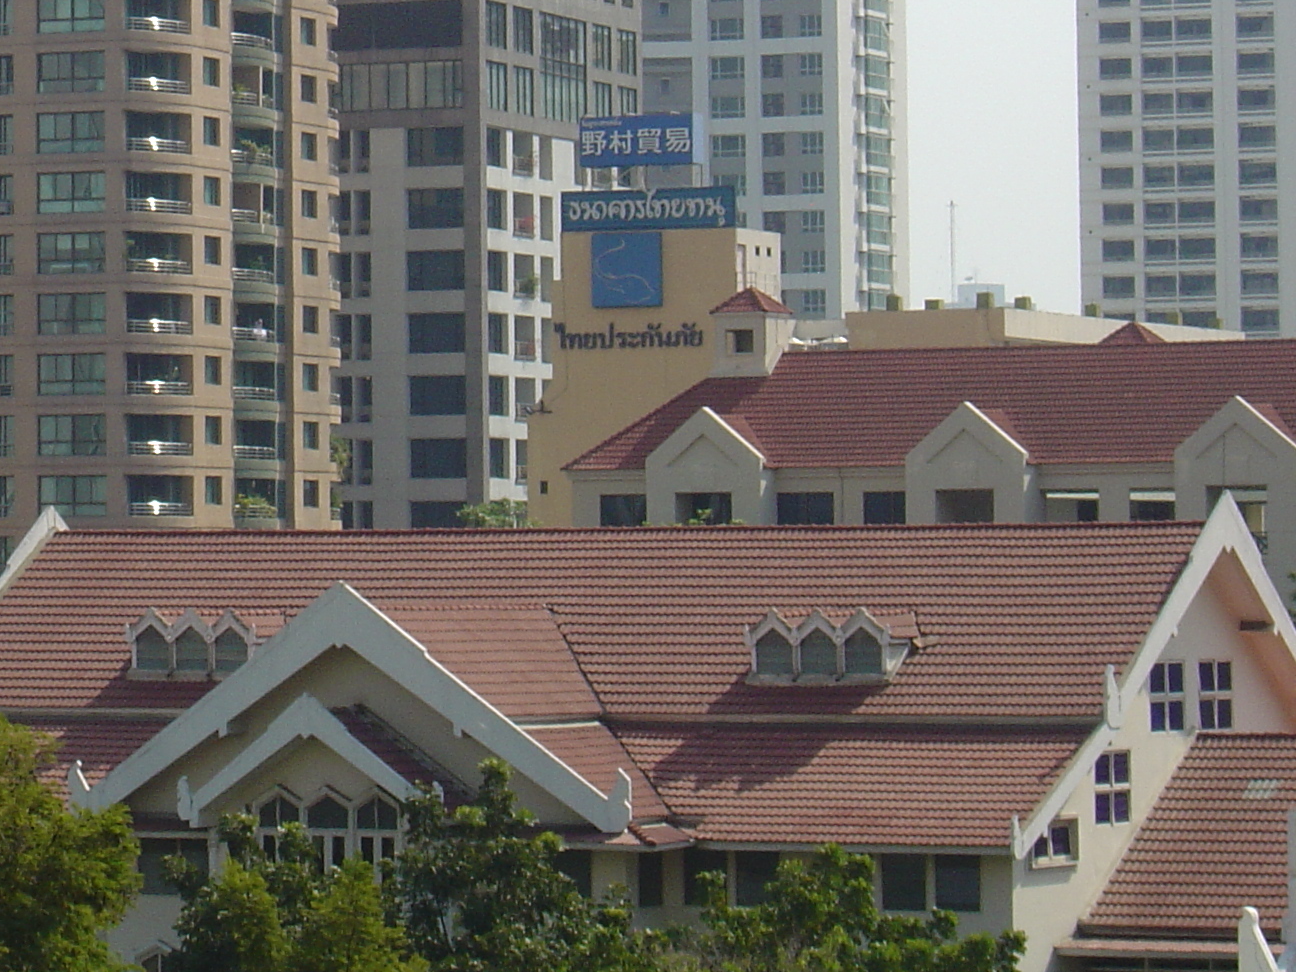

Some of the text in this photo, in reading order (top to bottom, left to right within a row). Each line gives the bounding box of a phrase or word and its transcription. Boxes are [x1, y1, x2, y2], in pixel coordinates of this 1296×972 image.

[581, 127, 691, 156] 野村貿易
[569, 189, 726, 226] ธนาคารไทยทนุ
[553, 322, 703, 349] ไทยประกันภัย
